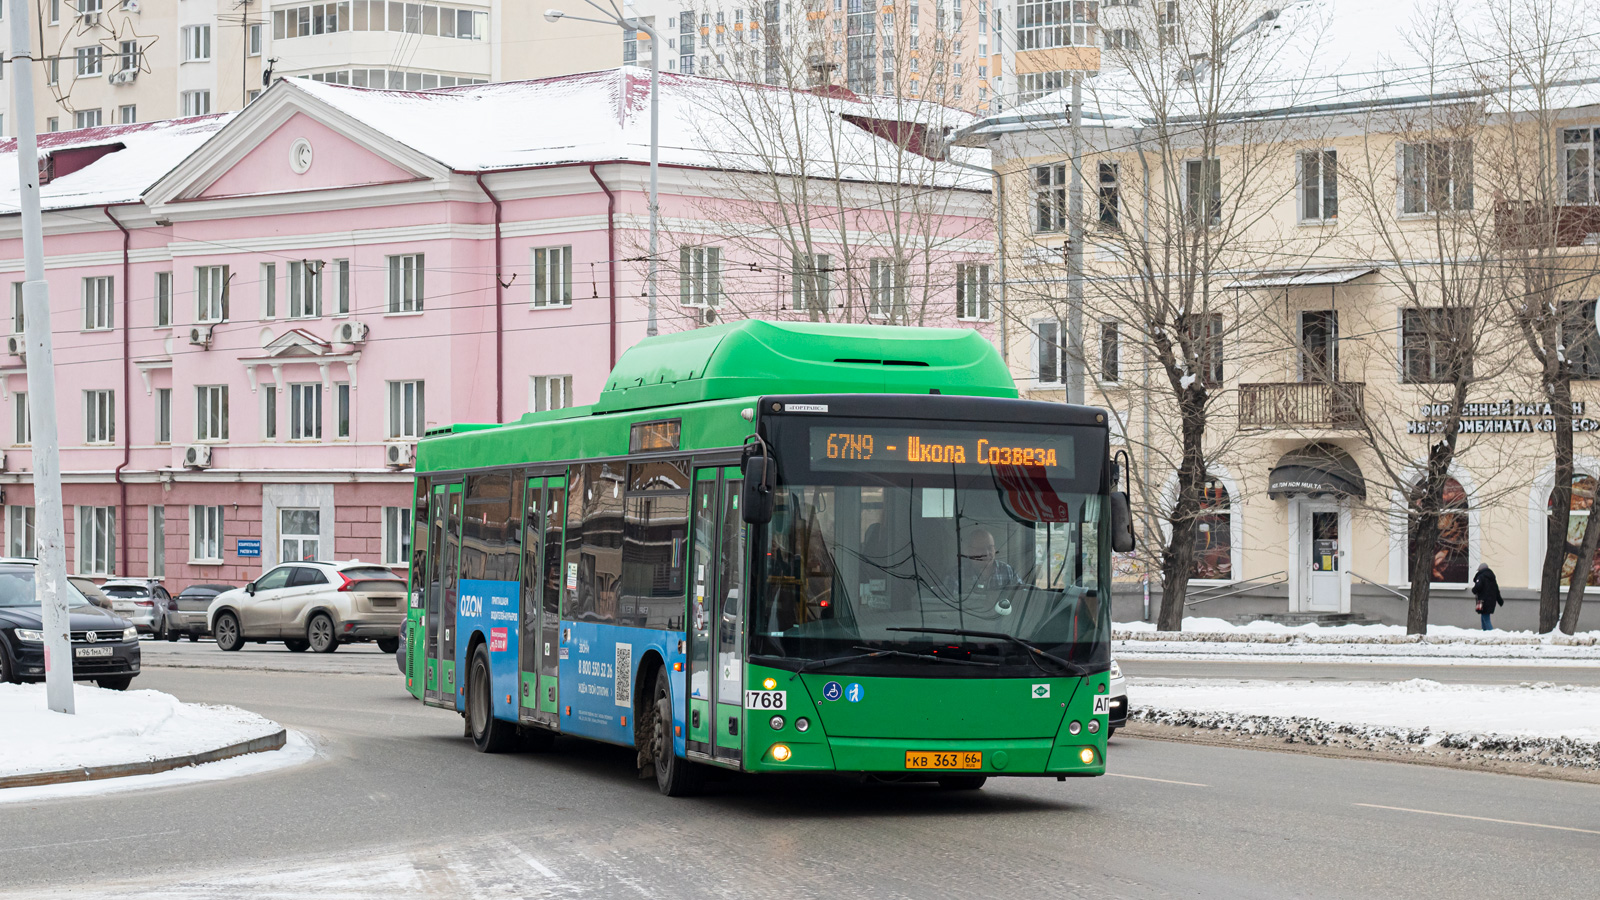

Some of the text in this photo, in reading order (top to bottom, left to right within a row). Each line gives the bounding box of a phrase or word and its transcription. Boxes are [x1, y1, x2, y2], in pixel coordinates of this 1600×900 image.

[1421, 400, 1584, 417] ФИРЕННЫЙ МАГАН
[1406, 419, 1600, 434] МЯСООМБИНАТА «ВЕС»
[908, 436, 966, 464] Школа
[460, 594, 483, 617] OZON
[582, 660, 592, 675] 800
[746, 691, 783, 708] 1768
[912, 753, 977, 767] КВ 363 66
